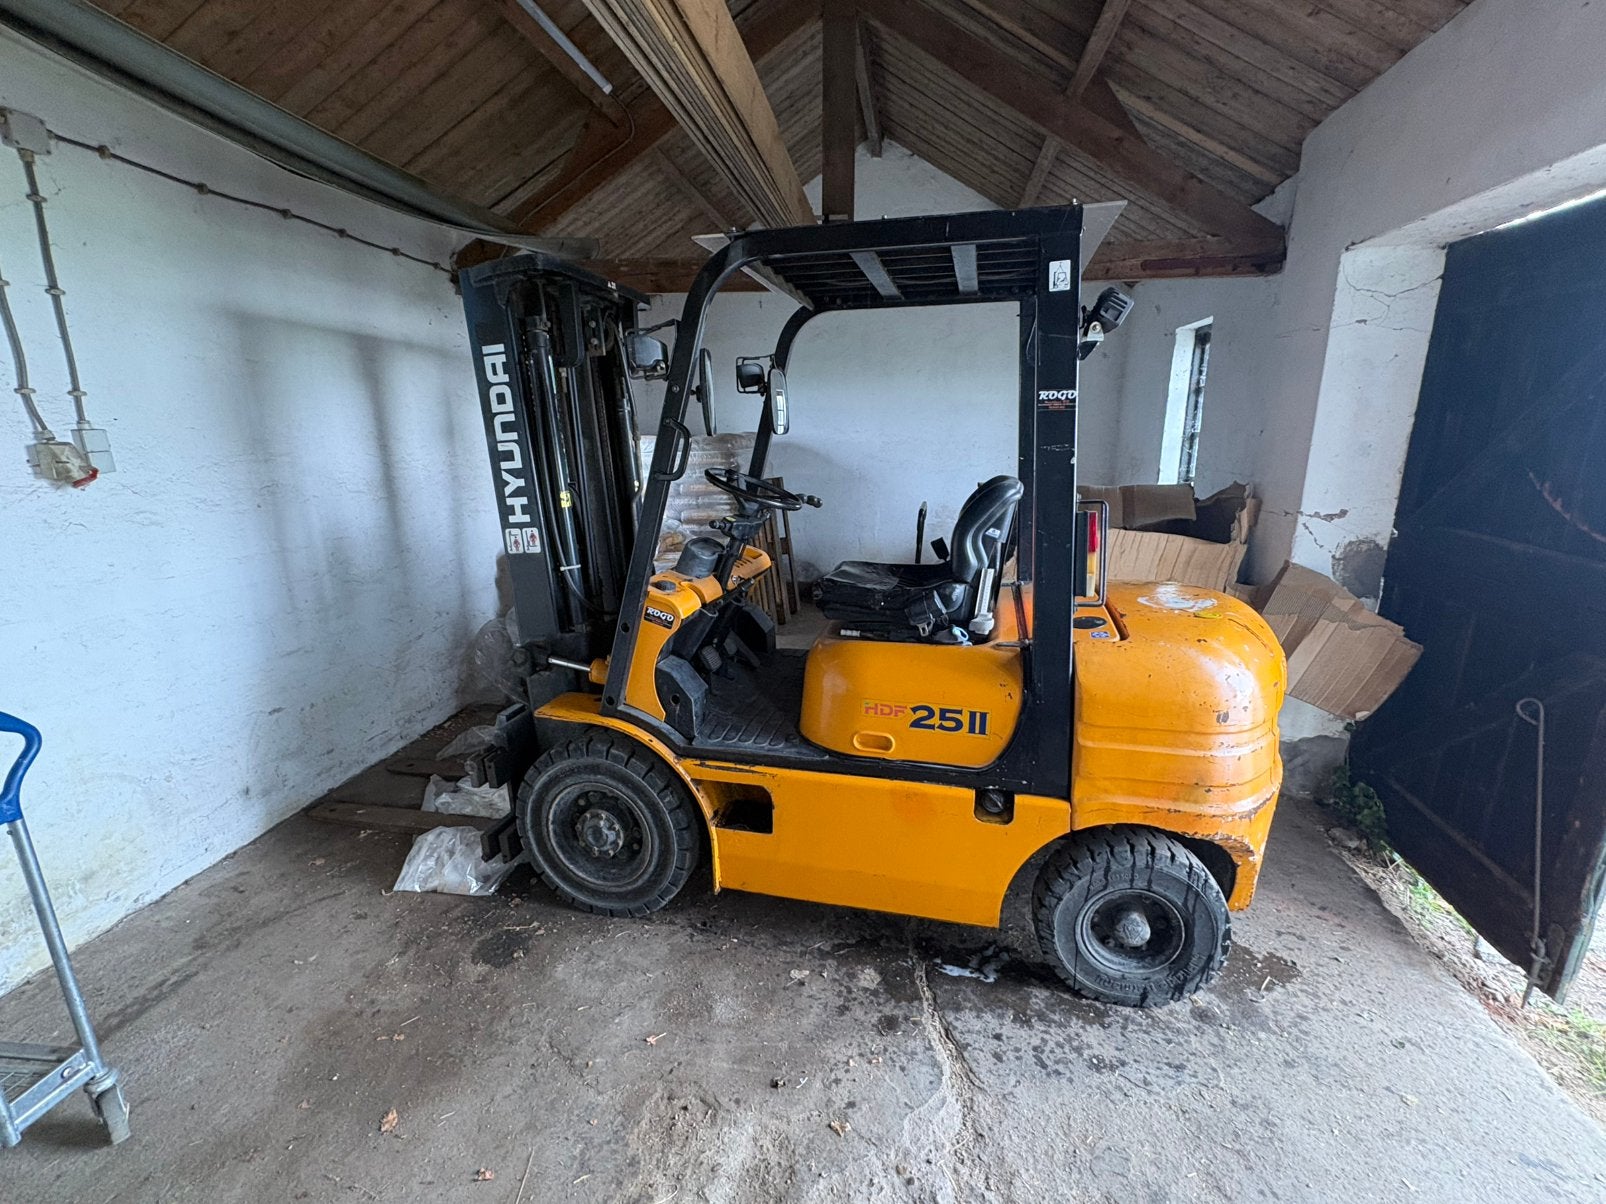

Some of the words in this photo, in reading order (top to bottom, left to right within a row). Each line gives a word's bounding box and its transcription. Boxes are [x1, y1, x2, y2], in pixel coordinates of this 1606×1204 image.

[1038, 390, 1077, 400] ROGO
[482, 343, 531, 523] HYUNDAI
[646, 607, 674, 622] ROGO
[864, 702, 907, 717] HDF
